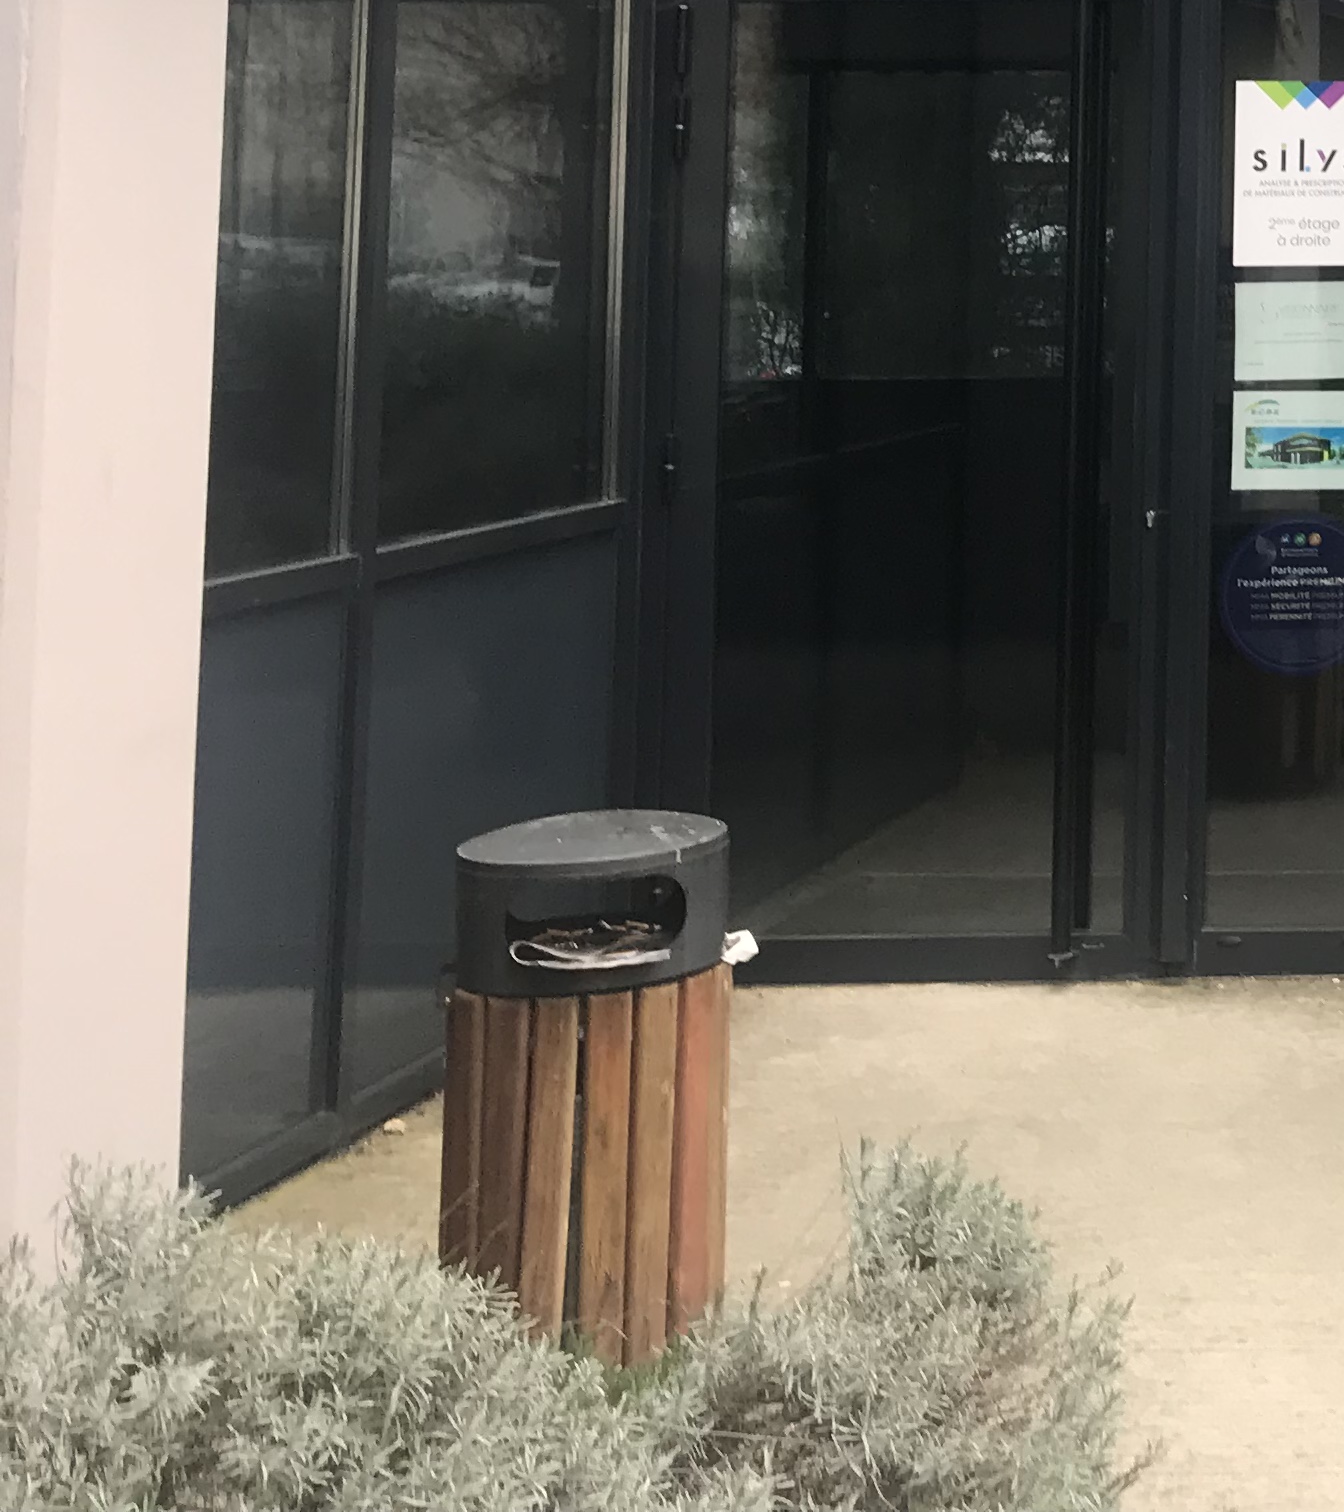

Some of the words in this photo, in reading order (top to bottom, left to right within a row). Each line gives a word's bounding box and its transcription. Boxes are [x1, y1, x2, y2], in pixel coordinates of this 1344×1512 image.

[1298, 217, 1340, 233] étage
[1277, 233, 1286, 246] à
[1290, 233, 1331, 246] droite
